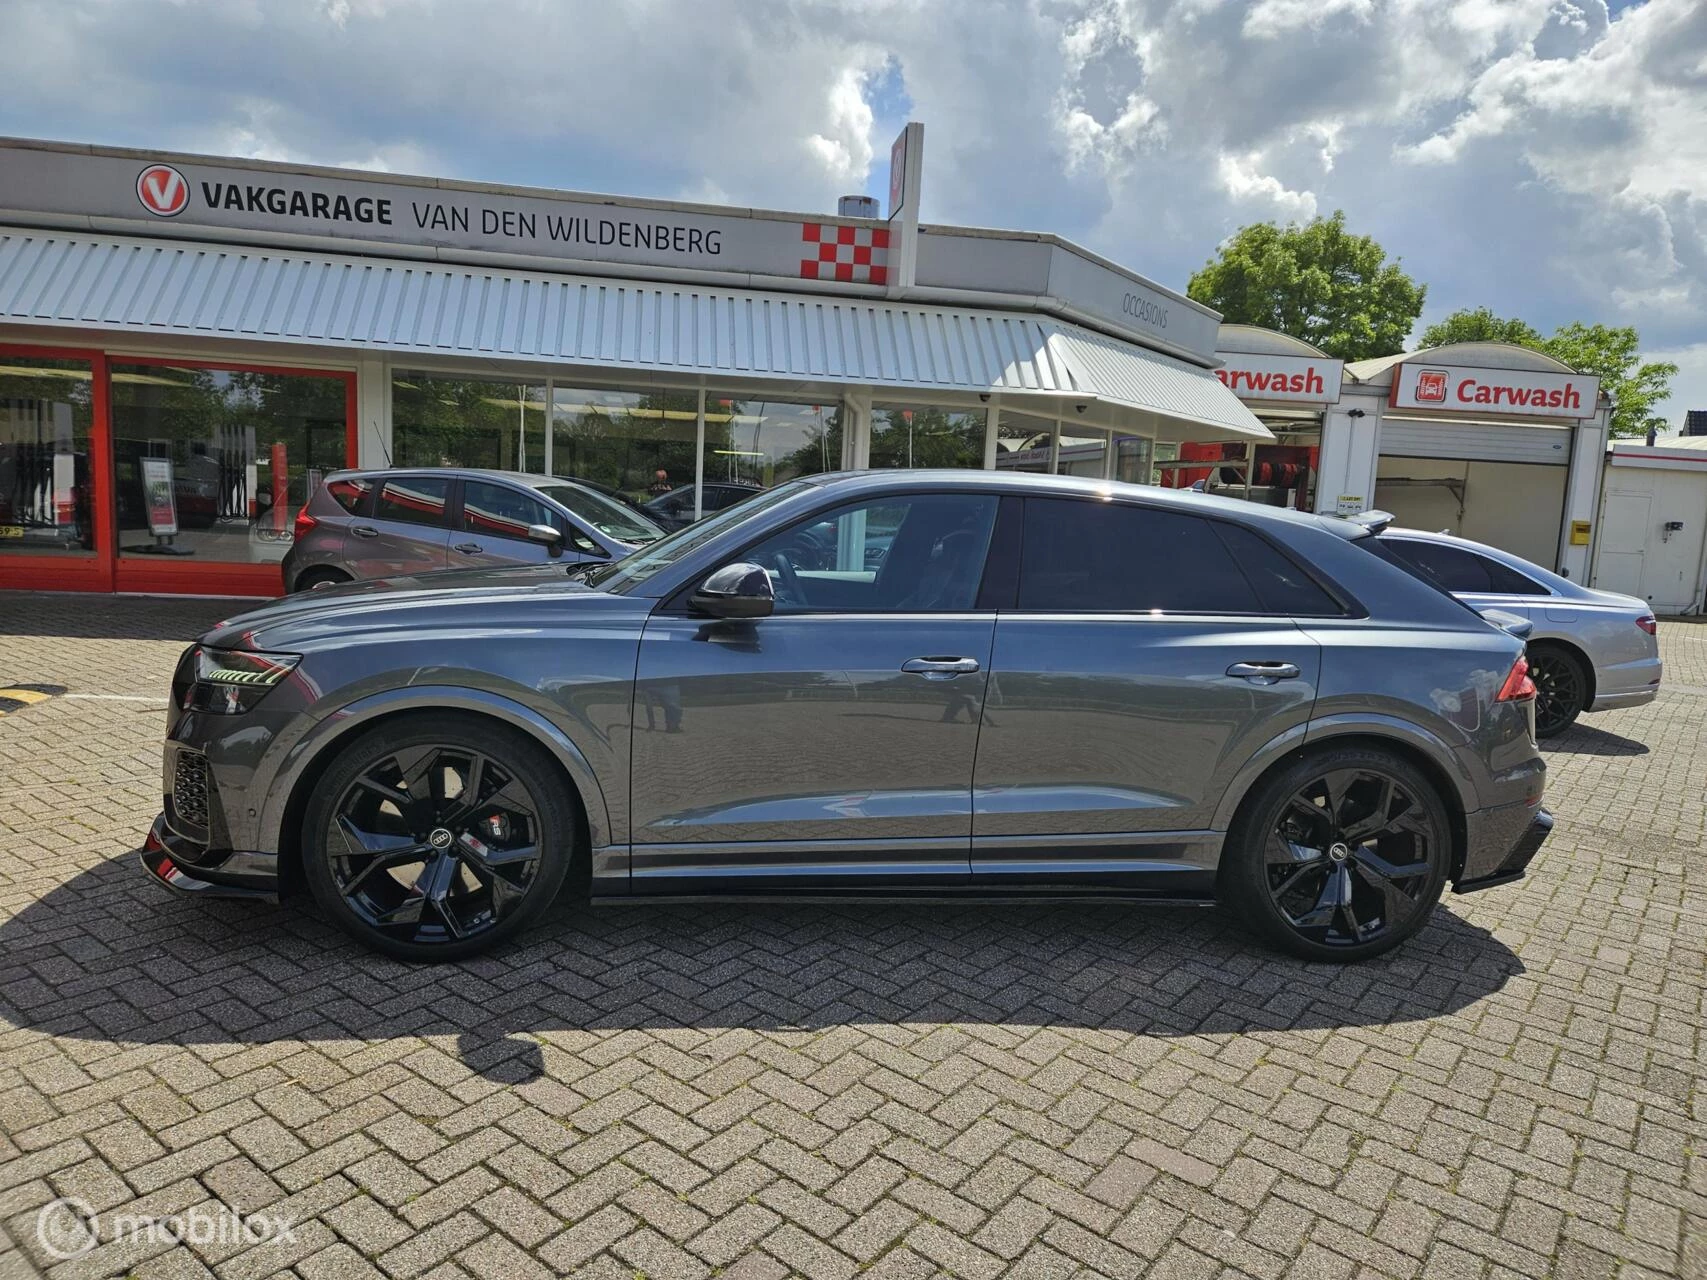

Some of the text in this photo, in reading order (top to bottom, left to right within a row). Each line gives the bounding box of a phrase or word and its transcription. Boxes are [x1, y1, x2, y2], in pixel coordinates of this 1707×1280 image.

[202, 182, 722, 255] VAKGARAGE VAN DEN WILDENBERG
[1122, 292, 1169, 329] OCCASIONS
[1214, 367, 1324, 394] arwash
[1457, 379, 1580, 409] Carwash
